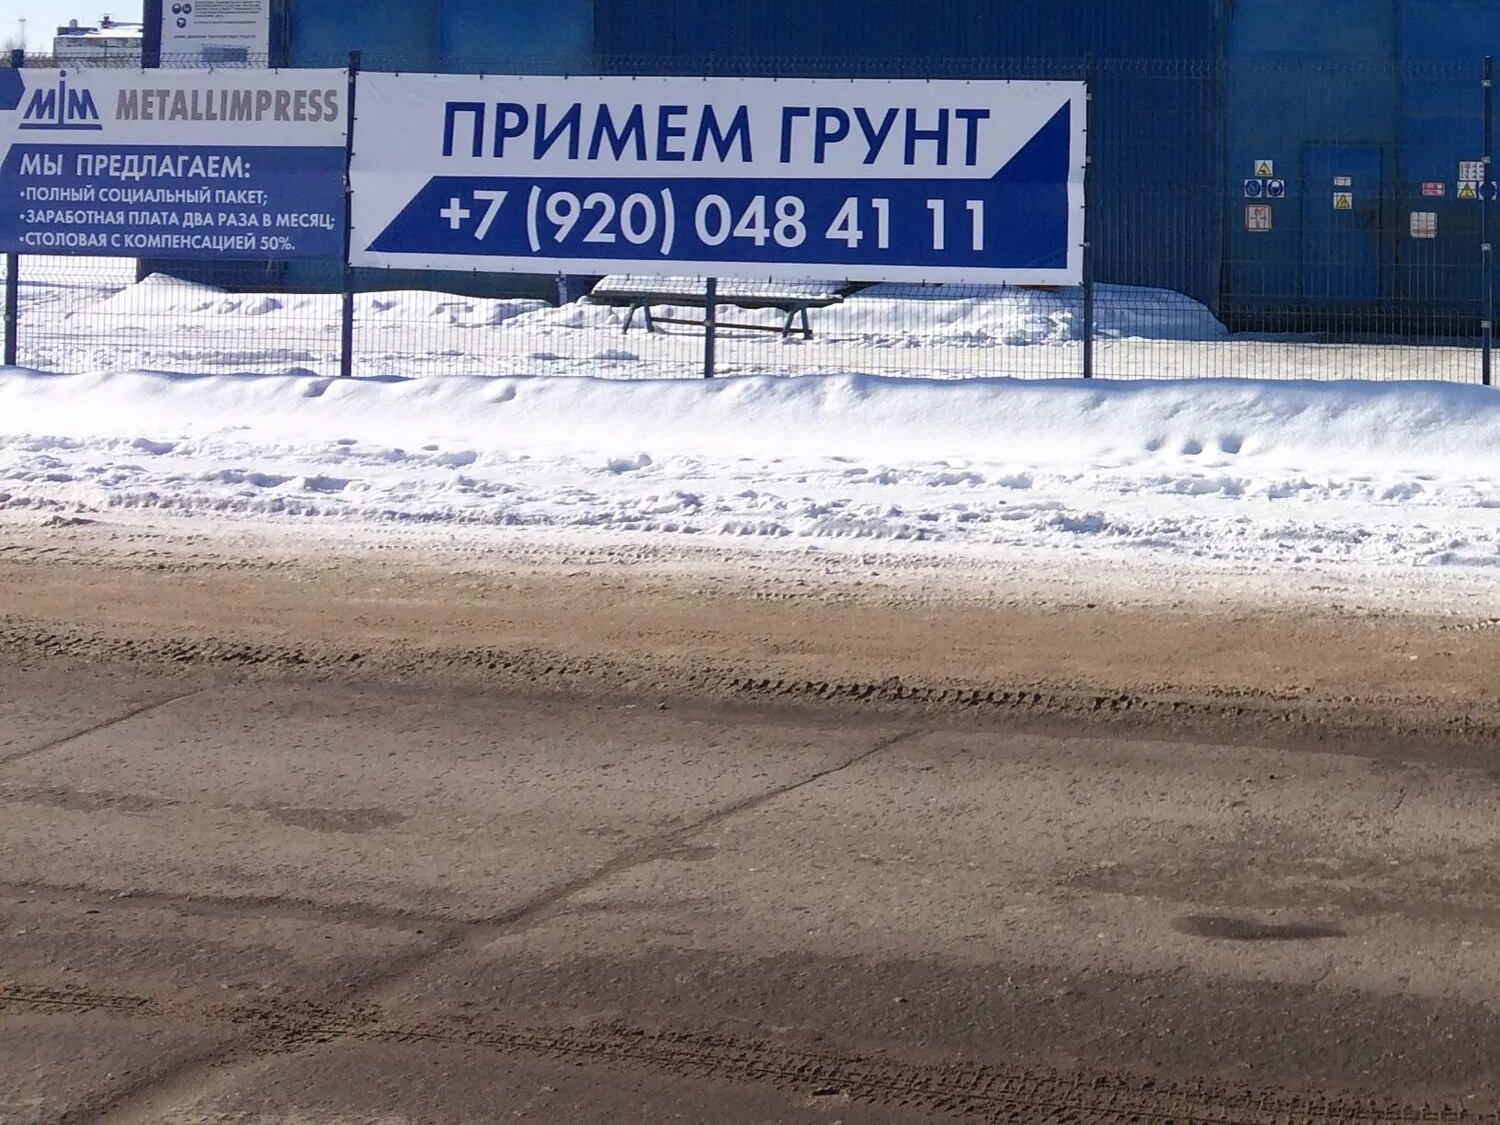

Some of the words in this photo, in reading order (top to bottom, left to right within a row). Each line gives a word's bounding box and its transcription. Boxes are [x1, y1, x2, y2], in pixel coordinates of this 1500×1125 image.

[115, 89, 339, 123] METALLIMPRESS
[442, 100, 754, 163] ПРИМЕМ
[779, 106, 991, 167] ГРУНТ
[20, 153, 63, 176] МЫ
[76, 153, 251, 181] ПРЕДЛАГАЕМ:
[98, 185, 211, 205] СОЦИАЛЬНЫЙ
[215, 190, 268, 206] ПАКЕТ;
[128, 211, 178, 225] ПЛАТА
[182, 212, 215, 228] ДВА
[218, 213, 258, 227] РАЗА
[262, 213, 271, 227] В
[277, 214, 336, 230] МЕСЯЦ;
[439, 189, 508, 241] +7
[526, 185, 674, 257] (920)
[694, 193, 806, 248] 048
[825, 196, 891, 250] 41
[926, 197, 986, 252] 11
[111, 234, 120, 247] С
[124, 232, 255, 251] КОМПЕНСАЦИЕЙ
[259, 236, 296, 251] 50%.
